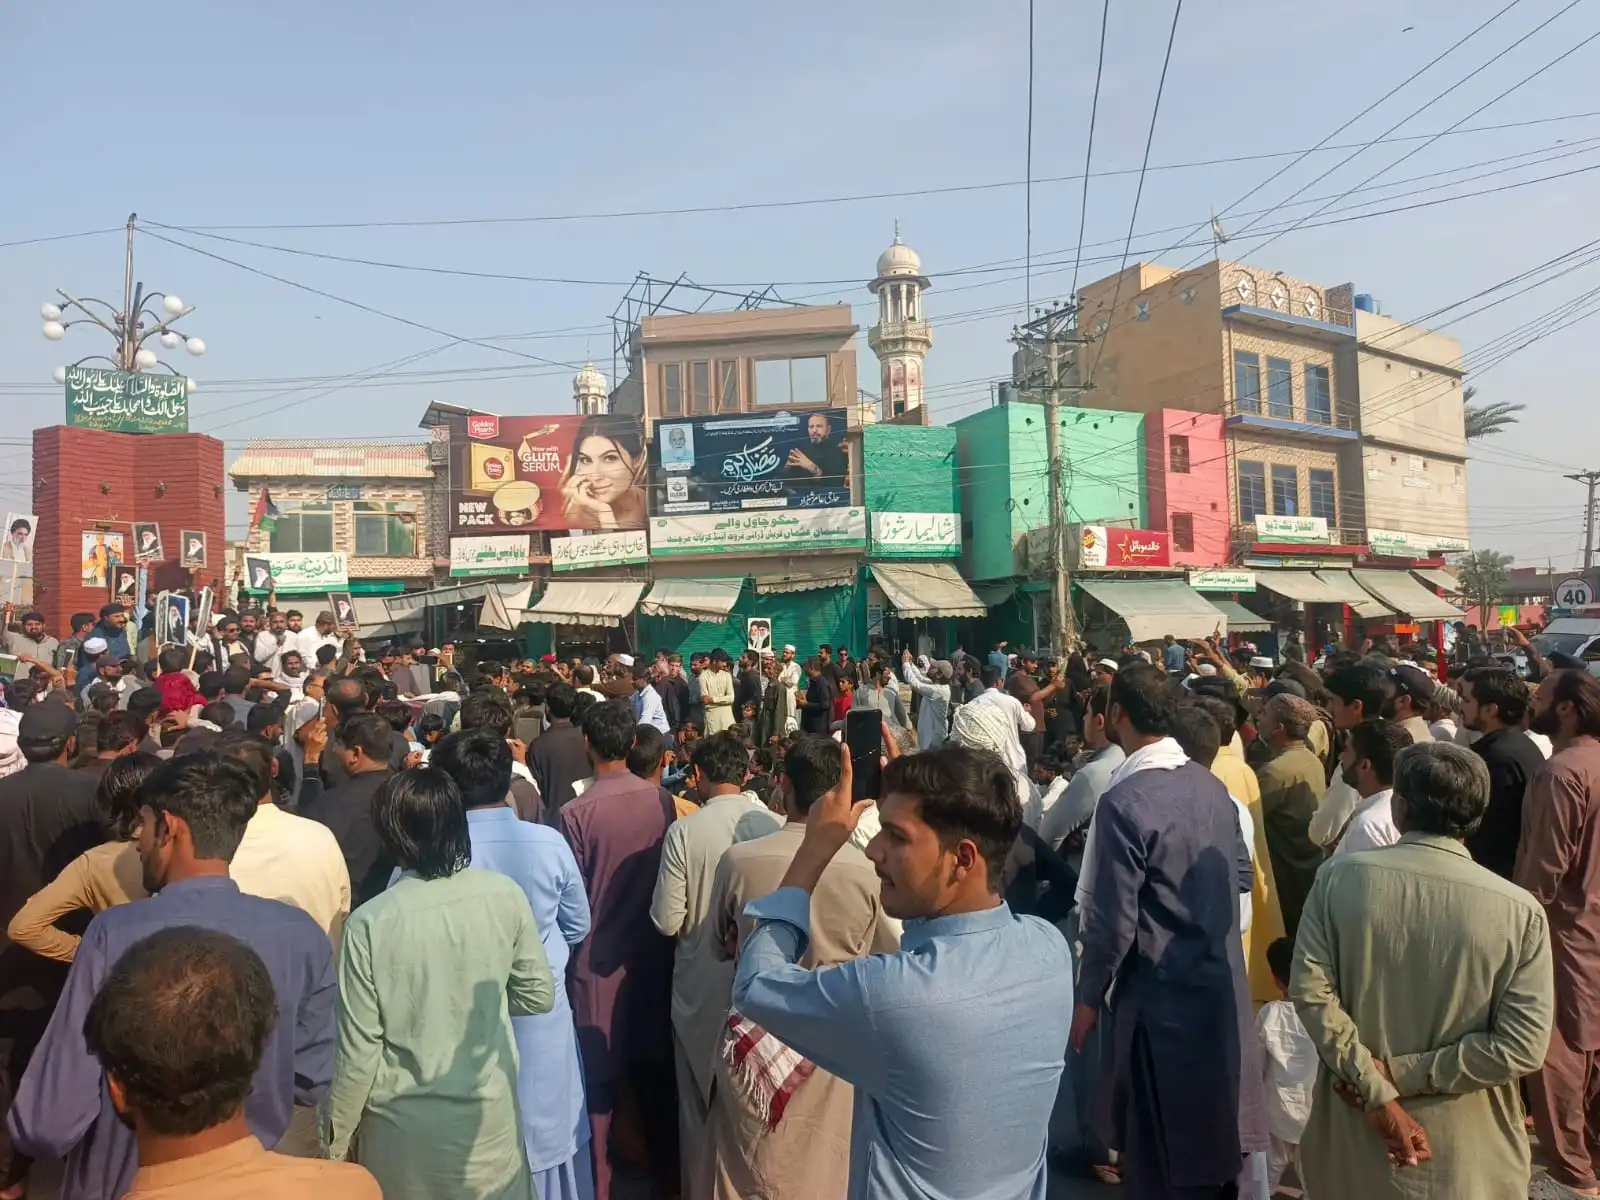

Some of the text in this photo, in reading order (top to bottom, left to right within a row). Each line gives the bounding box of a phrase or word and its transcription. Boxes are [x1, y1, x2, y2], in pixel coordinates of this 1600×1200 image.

[522, 452, 560, 463] GLUTA
[522, 462, 563, 473] SERUM
[458, 502, 488, 513] NEW
[458, 514, 495, 526] PACK
[880, 515, 907, 540] شوز
[1562, 589, 1586, 605] 40
